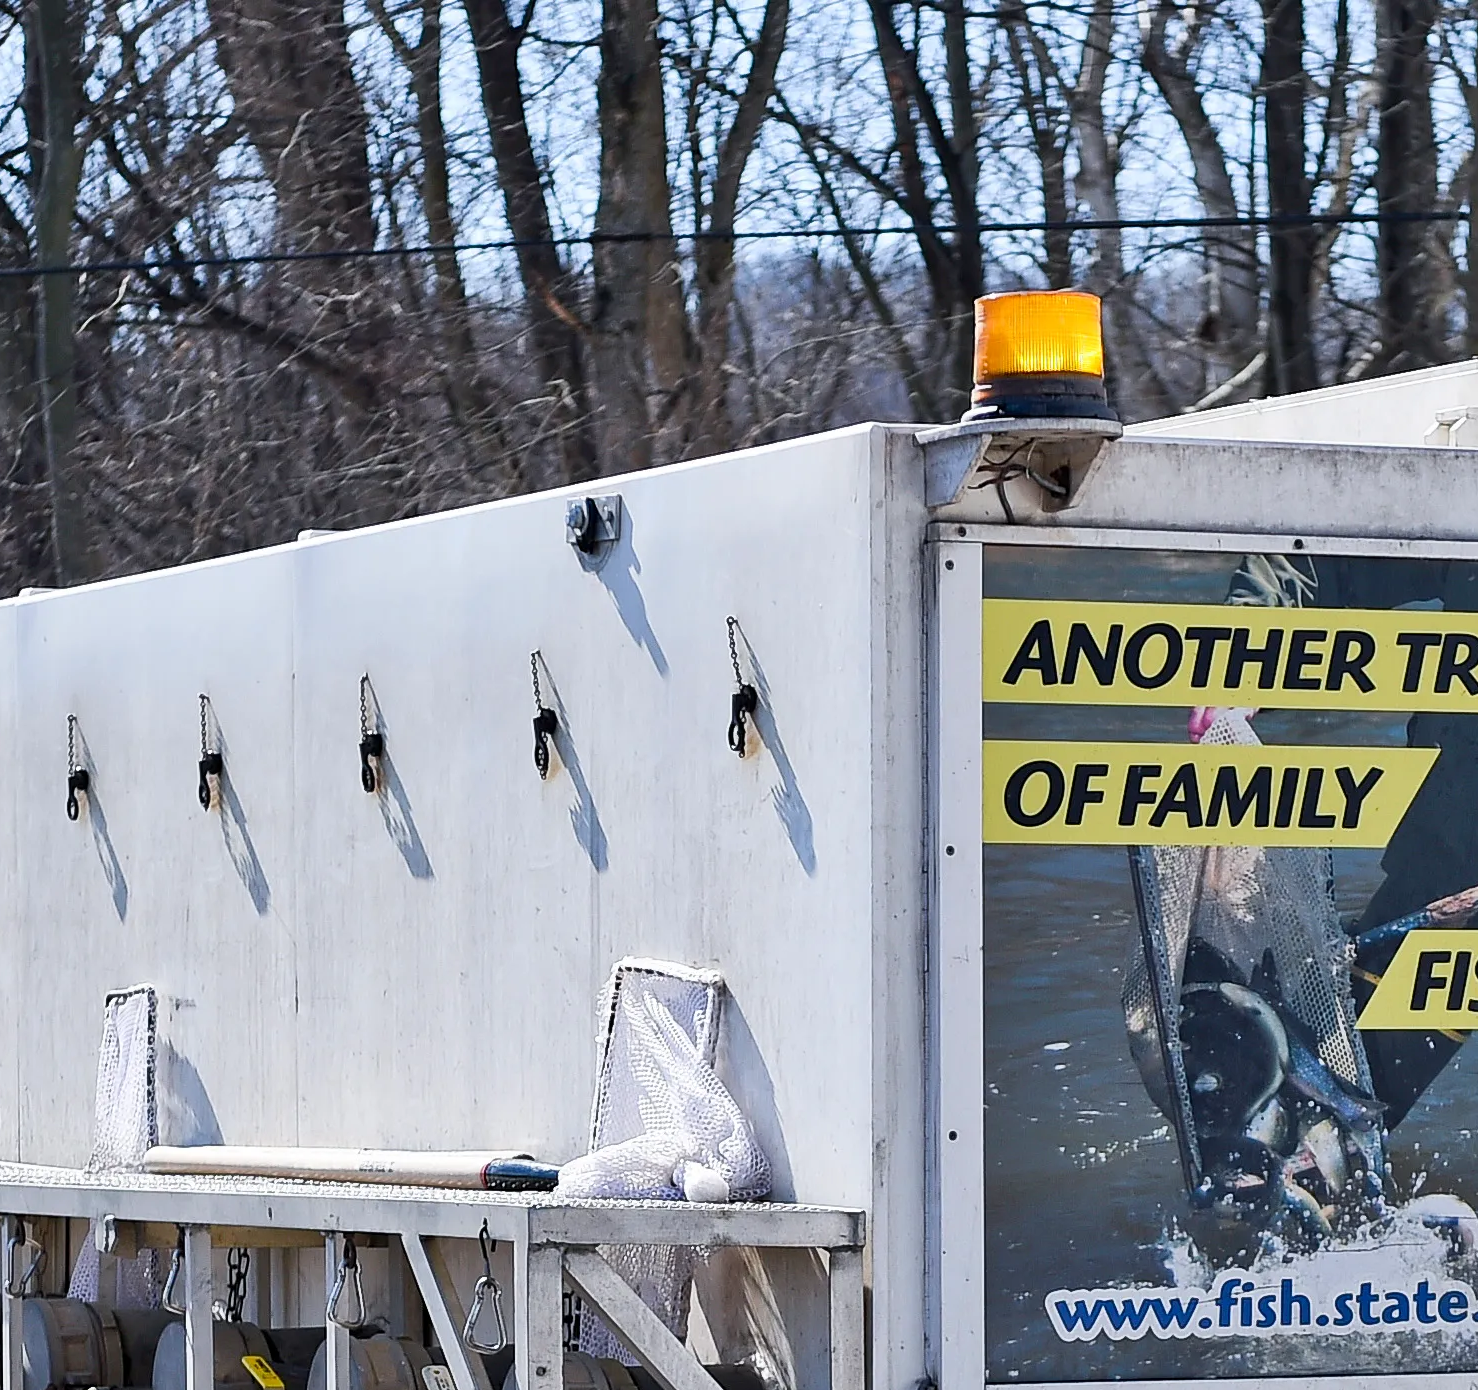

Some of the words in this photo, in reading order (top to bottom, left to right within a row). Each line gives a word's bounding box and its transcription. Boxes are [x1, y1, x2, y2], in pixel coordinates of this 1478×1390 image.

[1001, 619, 1377, 694] ANOTHER
[1003, 760, 1110, 828] OF
[1117, 762, 1385, 829] FAMILY
